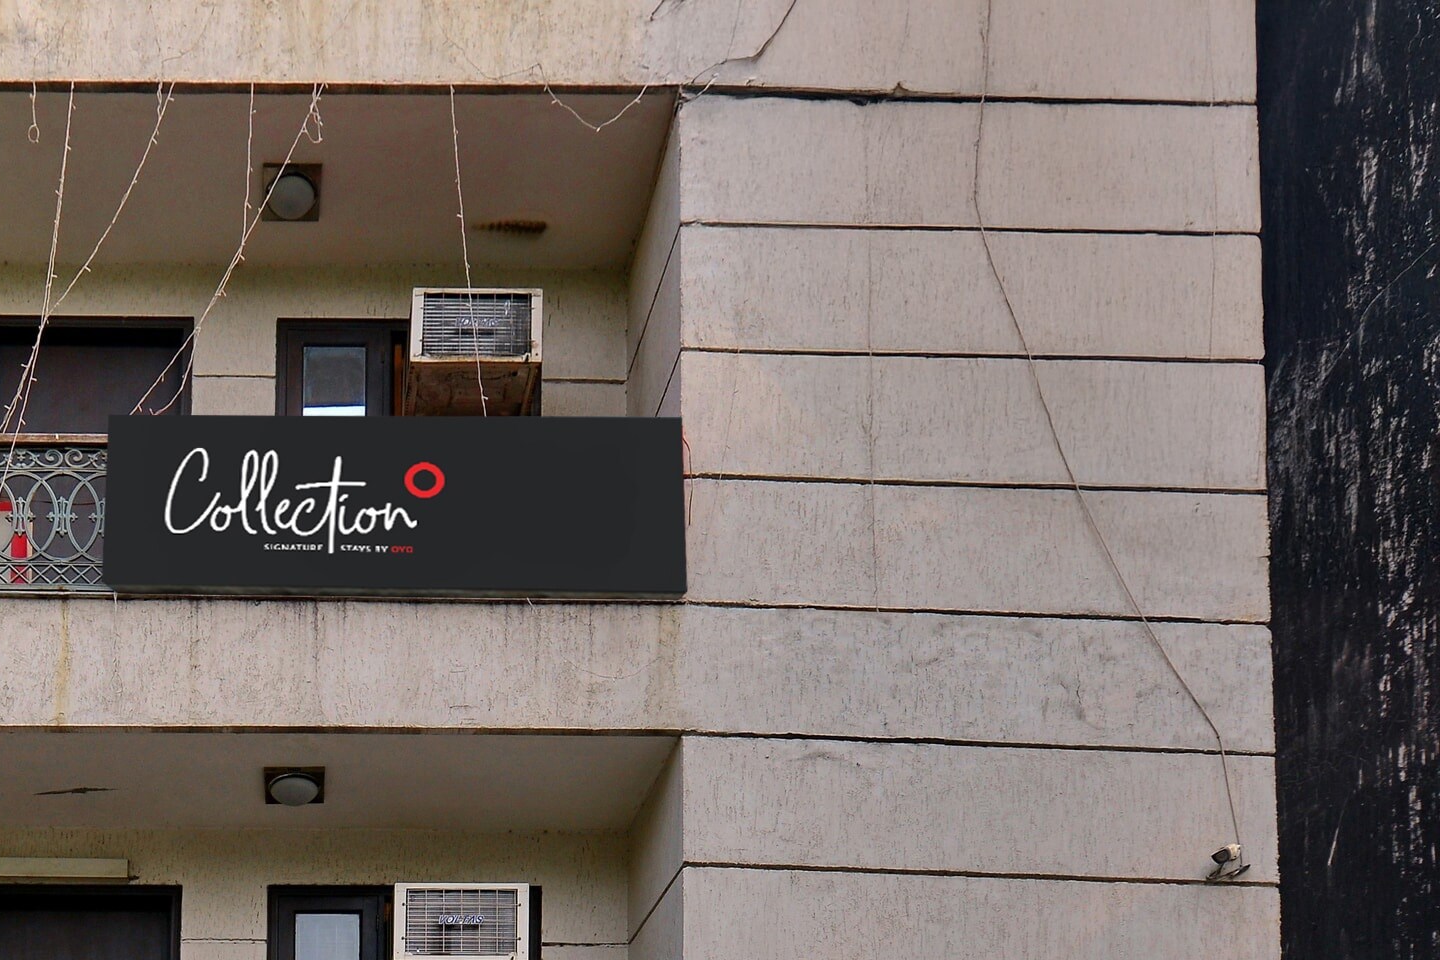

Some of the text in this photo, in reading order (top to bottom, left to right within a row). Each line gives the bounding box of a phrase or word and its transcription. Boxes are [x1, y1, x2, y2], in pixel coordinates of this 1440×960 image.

[164, 447, 418, 554] Collection
[263, 543, 324, 551] SIGNATURE
[340, 544, 372, 553] STAYS
[374, 545, 389, 553] BY
